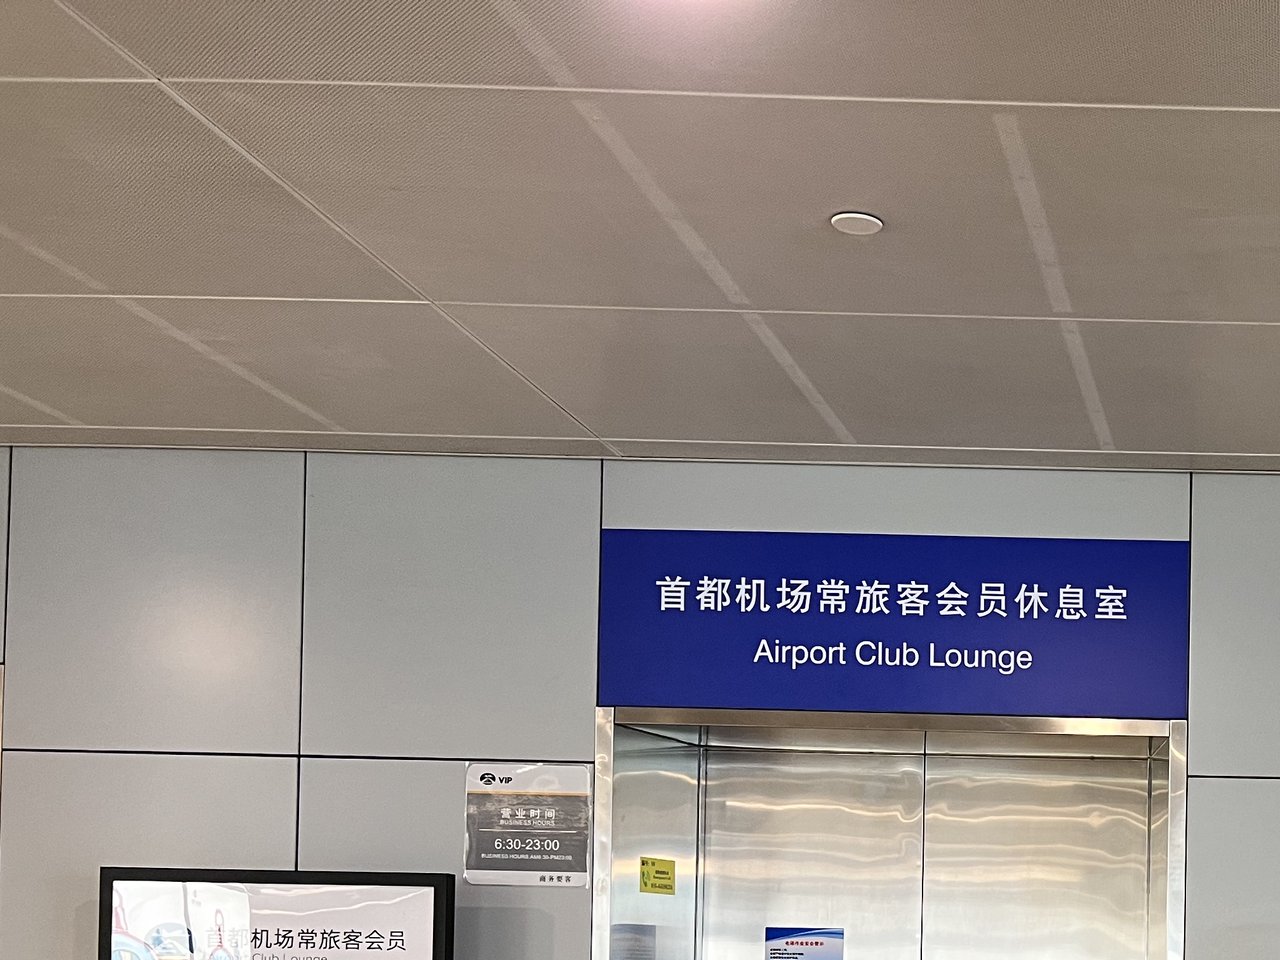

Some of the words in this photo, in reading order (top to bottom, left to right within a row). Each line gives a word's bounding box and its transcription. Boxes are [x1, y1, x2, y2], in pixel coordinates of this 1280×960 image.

[655, 575, 1129, 620] 首都机场常旅客会员休息室
[753, 639, 846, 669] Airport
[855, 641, 920, 667] Club
[929, 643, 1034, 675] Lounge
[498, 776, 513, 785] VIP
[500, 807, 556, 820] 营业时间
[494, 838, 560, 851] 6:30-23:00
